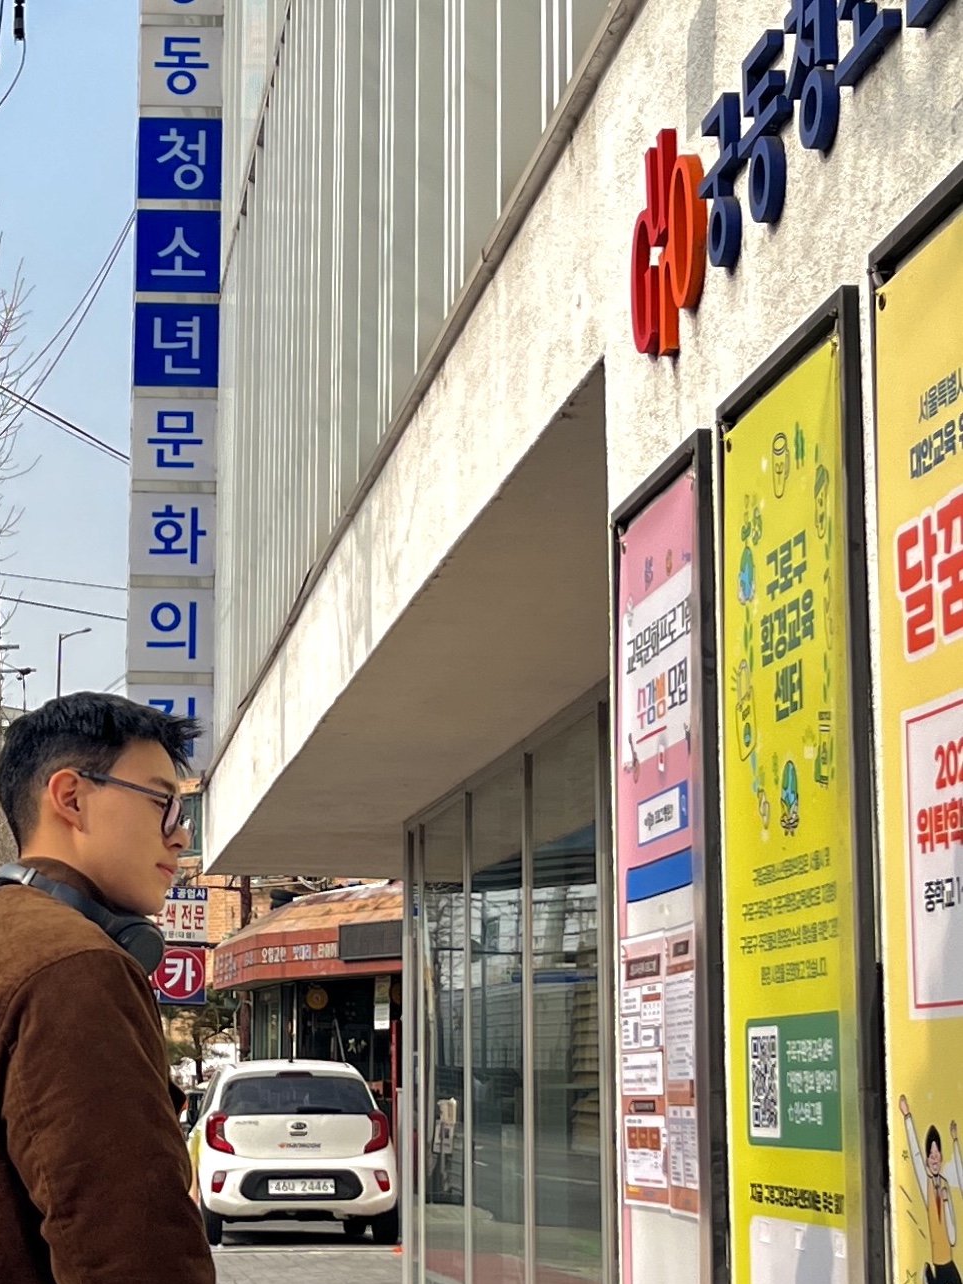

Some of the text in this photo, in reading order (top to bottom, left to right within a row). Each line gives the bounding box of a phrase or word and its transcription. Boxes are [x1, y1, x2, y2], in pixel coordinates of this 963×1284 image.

[146, 0, 209, 757] 동청소년문화의
[910, 419, 956, 479] 대안교육
[766, 529, 807, 601] 구로구
[760, 597, 816, 668] 환경교육
[667, 656, 687, 710] 모집
[775, 659, 804, 722] 센터
[177, 888, 206, 899] 공업사
[182, 904, 205, 930] 전문
[301, 1181, 329, 1191] 2446
